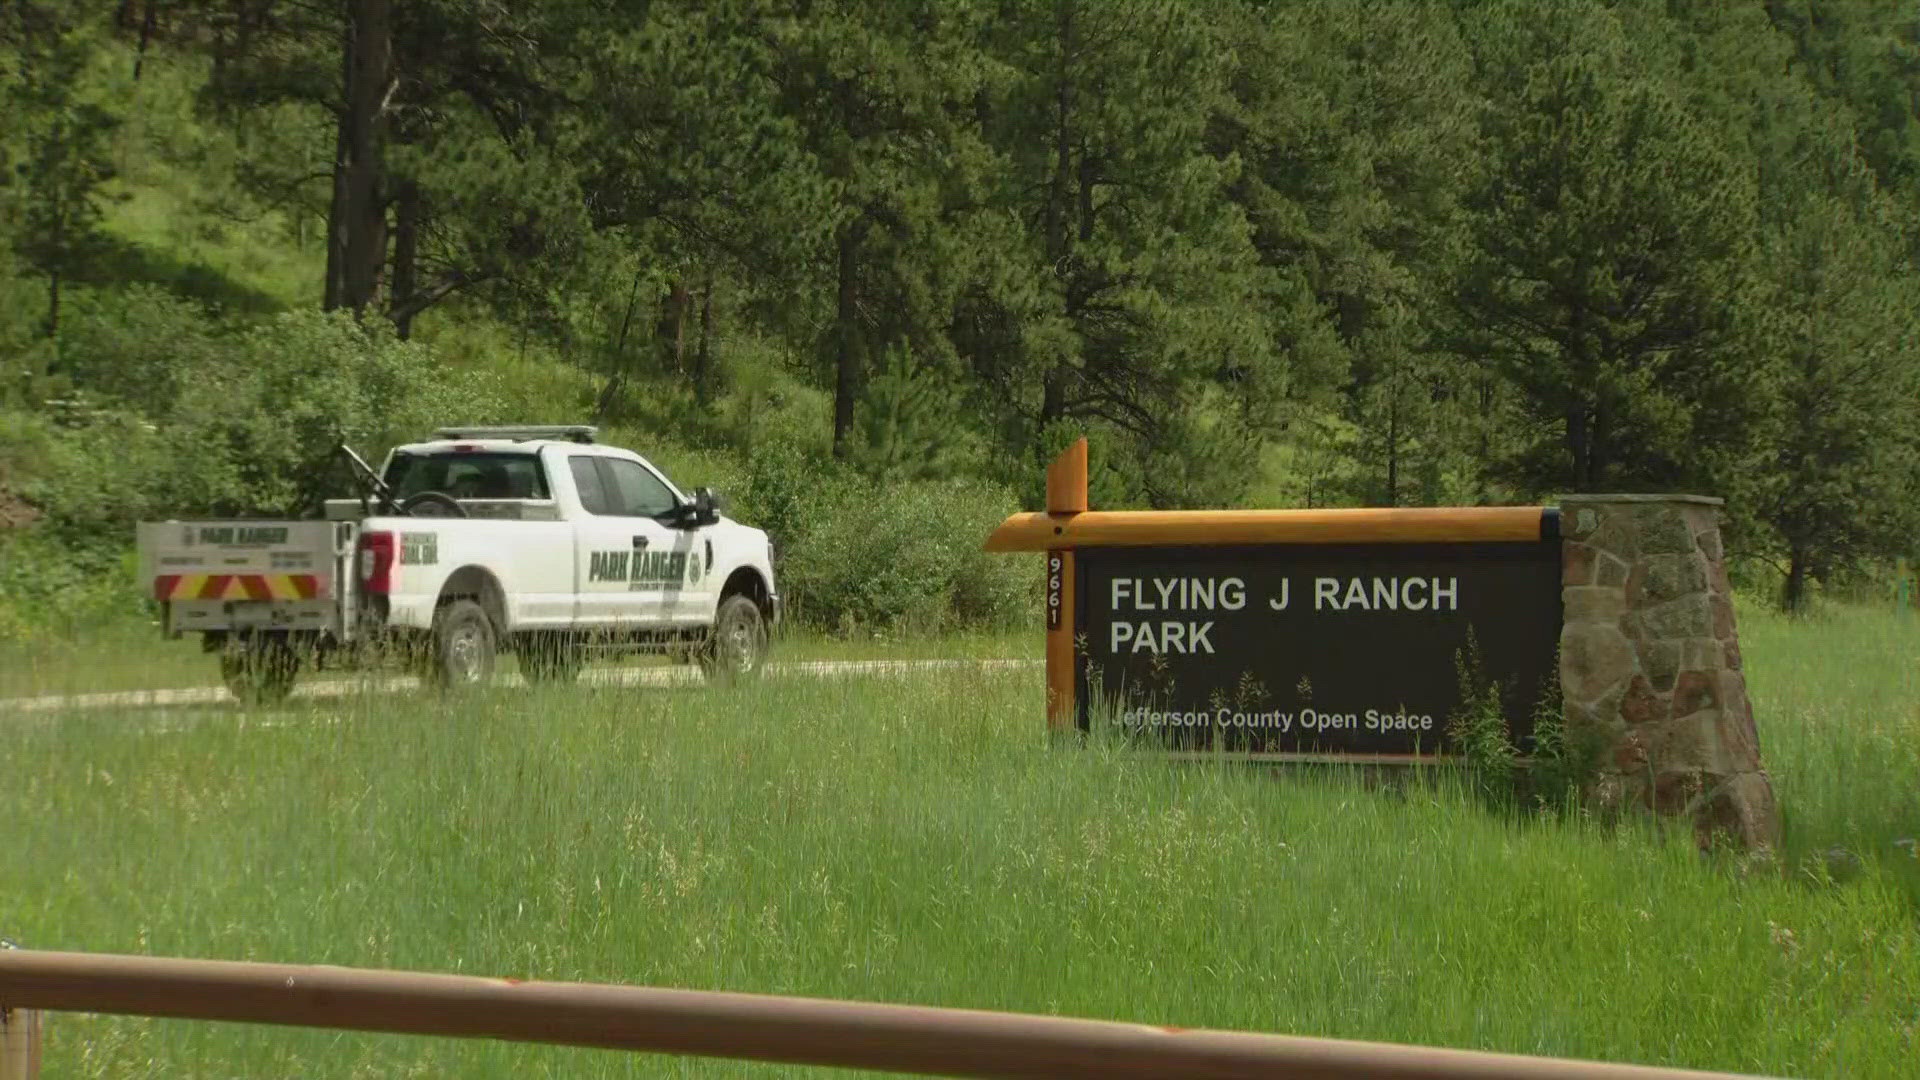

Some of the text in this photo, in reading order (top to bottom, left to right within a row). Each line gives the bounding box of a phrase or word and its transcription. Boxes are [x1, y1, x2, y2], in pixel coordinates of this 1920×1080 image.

[589, 551, 685, 582] PARK RANGER
[1049, 558, 1061, 624] 9661
[1111, 576, 1457, 610] FLYING J RANCH
[1111, 621, 1215, 654] PARK
[1217, 708, 1293, 733] County
[1300, 708, 1357, 732] Open
[1365, 709, 1433, 733] Space
